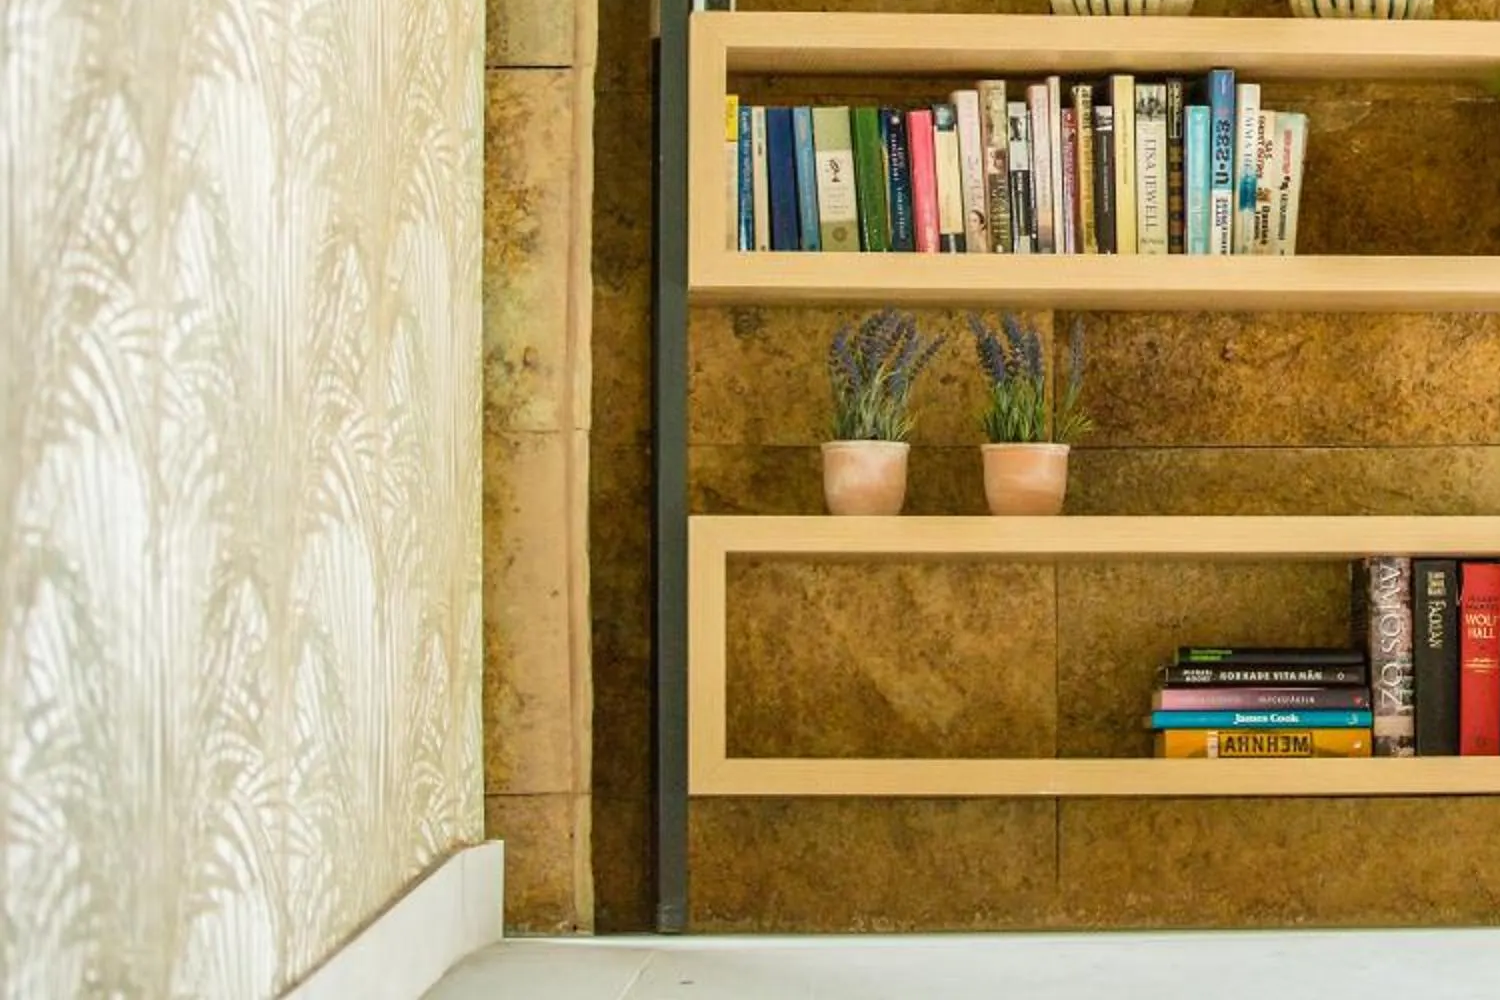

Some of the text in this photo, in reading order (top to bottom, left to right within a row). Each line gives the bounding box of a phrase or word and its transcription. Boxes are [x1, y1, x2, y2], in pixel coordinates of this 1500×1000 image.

[1144, 139, 1159, 232] LISA JEWELL
[1465, 613, 1500, 627] WOLF
[1378, 563, 1403, 708] AMOS OZ
[1468, 628, 1497, 639] HALL
[1233, 713, 1300, 725] James Cook
